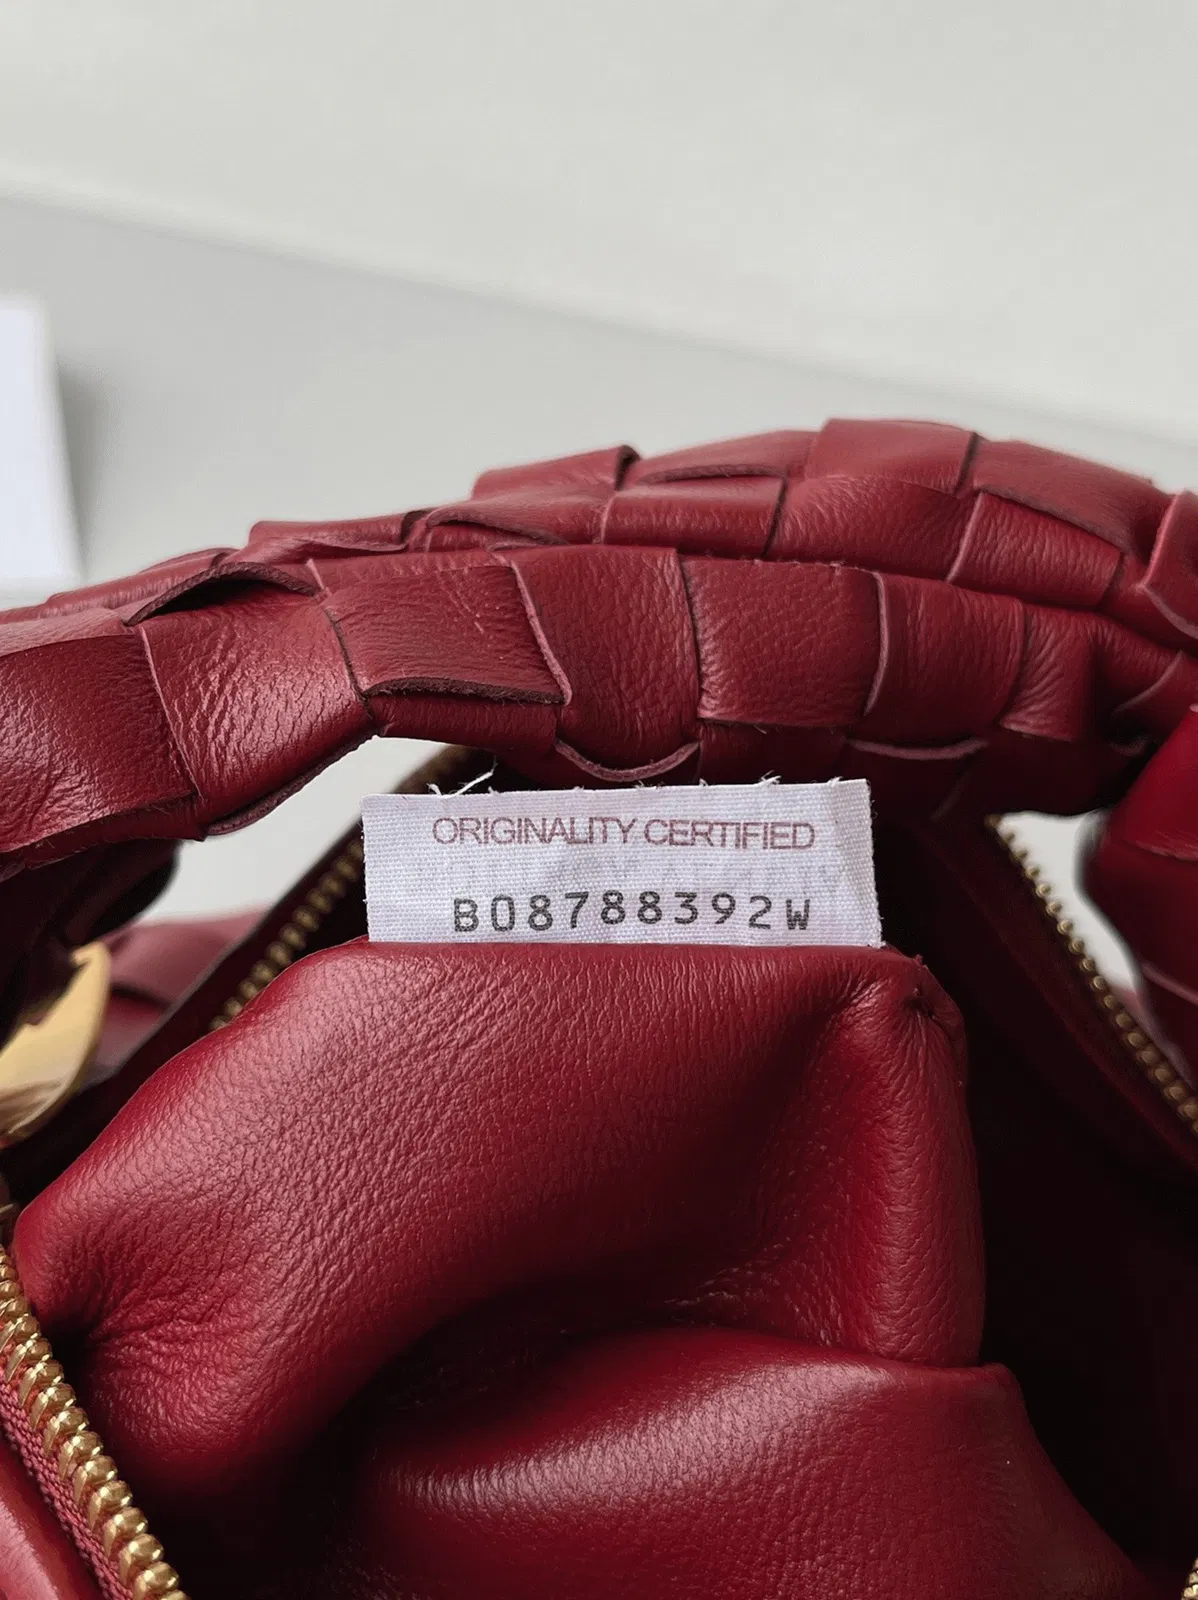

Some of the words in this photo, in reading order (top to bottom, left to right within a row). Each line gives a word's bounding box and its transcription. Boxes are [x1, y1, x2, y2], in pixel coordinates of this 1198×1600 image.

[433, 816, 636, 846] ORIGINALITY
[644, 817, 816, 850] CERTIFIED
[453, 890, 811, 932] B08788392W
